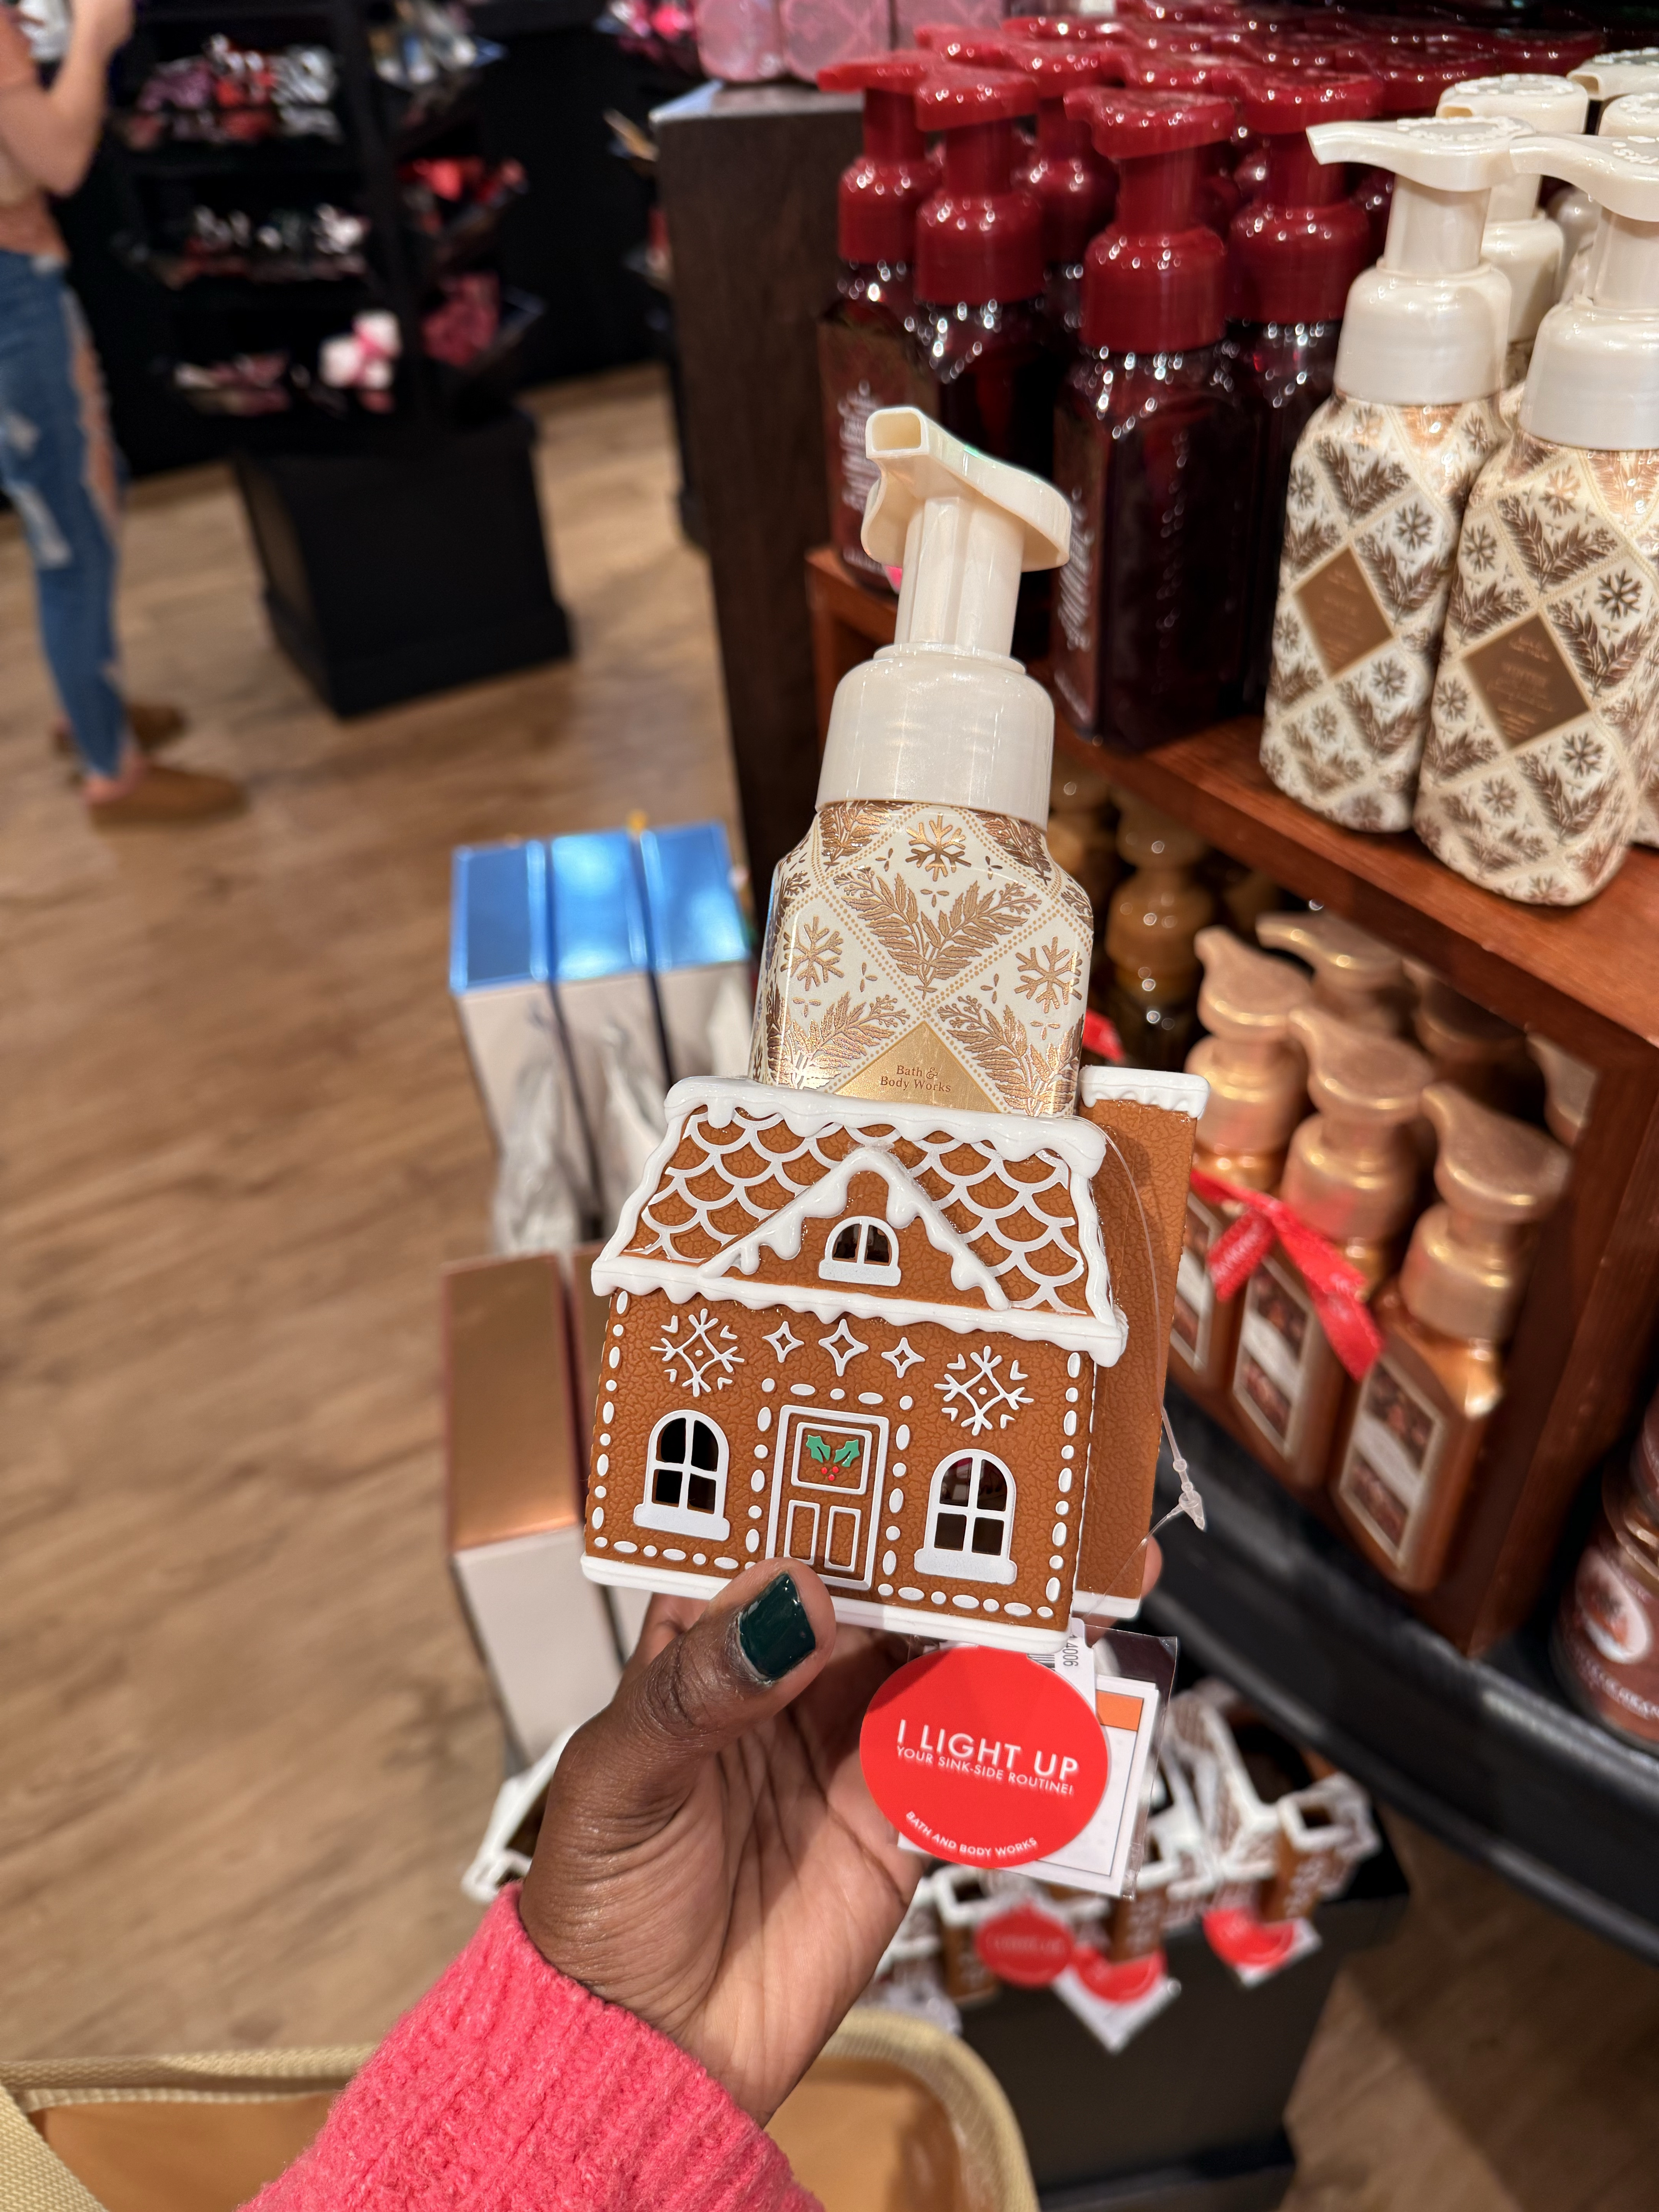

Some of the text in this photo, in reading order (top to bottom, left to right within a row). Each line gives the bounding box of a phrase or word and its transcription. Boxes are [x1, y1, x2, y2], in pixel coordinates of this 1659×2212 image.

[880, 1076, 951, 1092] Body Works
[896, 1065, 938, 1079] Bath &
[896, 1745, 1073, 1795] YOUR SINK-SIDE ROUTINE!
[897, 1719, 1079, 1781] I LIGHT UP
[905, 1810, 1037, 1856] BATH AND BODY WORKS
